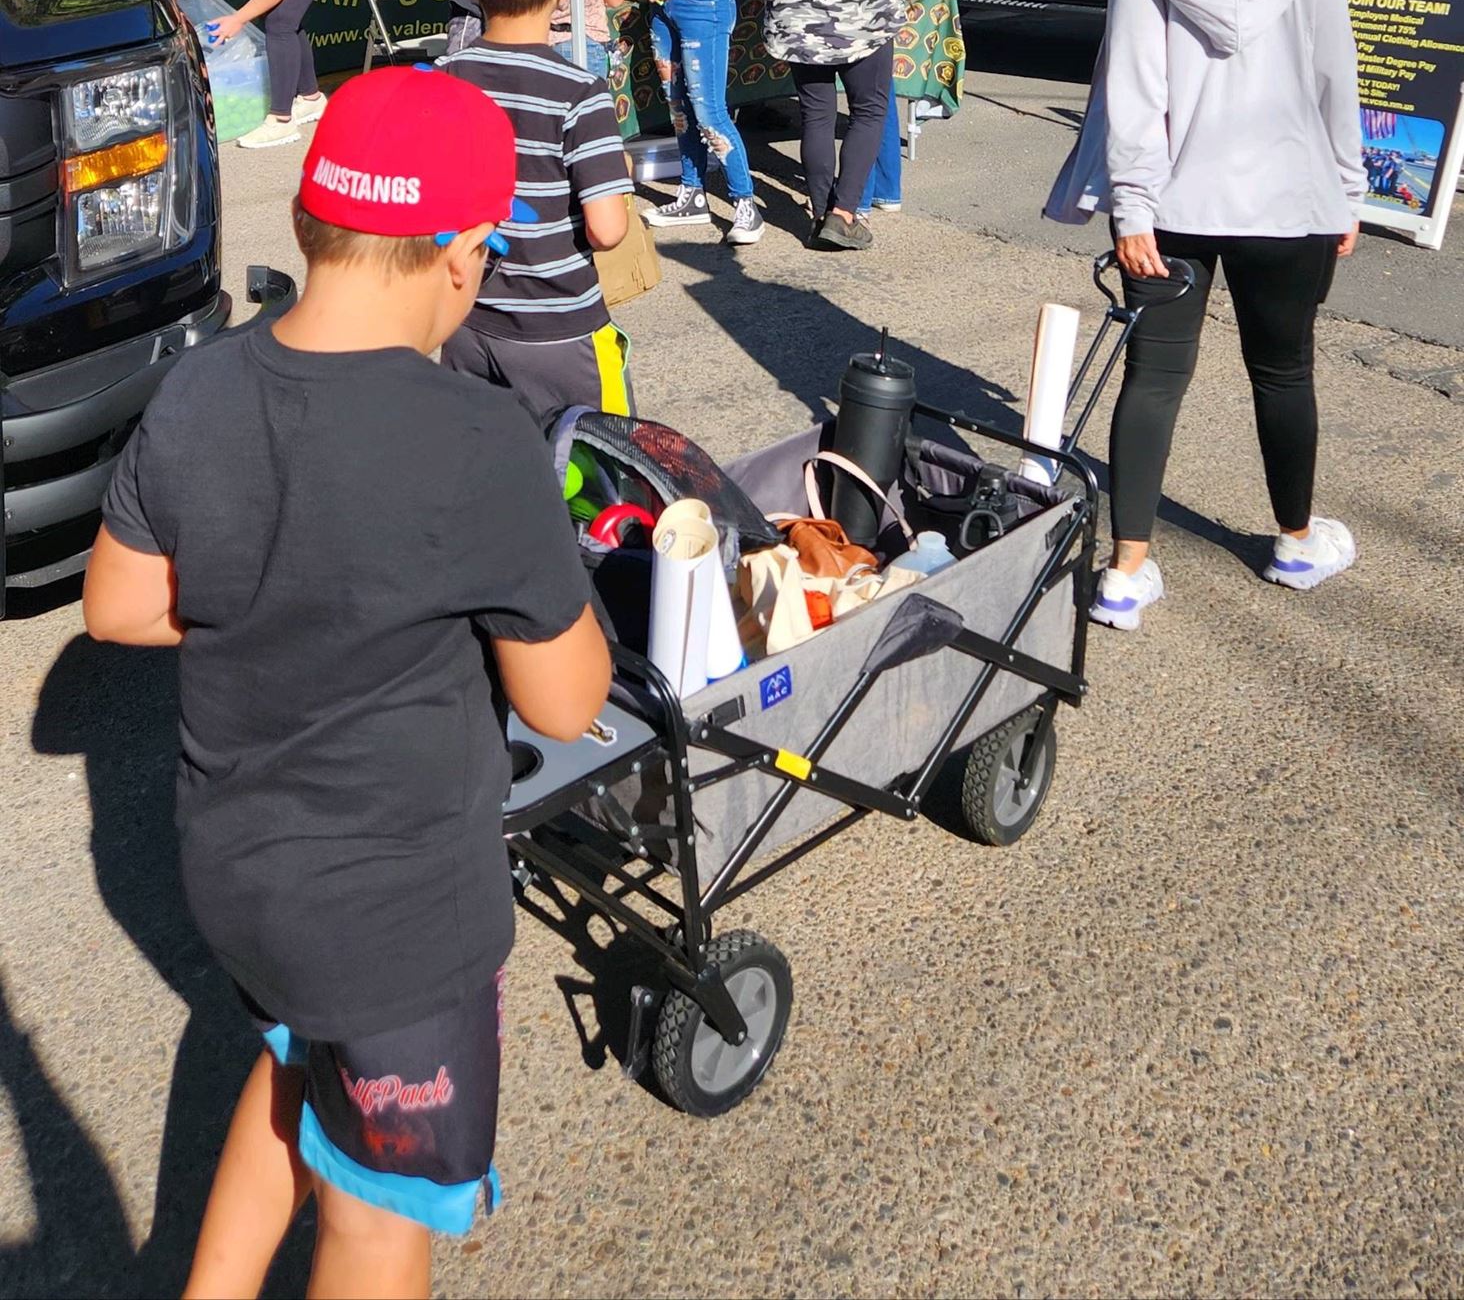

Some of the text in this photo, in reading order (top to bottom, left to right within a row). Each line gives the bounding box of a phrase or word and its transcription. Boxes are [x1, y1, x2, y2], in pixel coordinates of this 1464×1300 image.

[1408, 0, 1451, 15] TEAM!
[1349, 8, 1425, 25] Employee Medical
[1352, 20, 1417, 35] tirement at 75%
[1352, 30, 1381, 42] Annual
[1381, 34, 1419, 48] Clothing
[1357, 42, 1375, 53] Pay
[1386, 56, 1417, 69] Degree
[1418, 61, 1437, 72] Pay
[1365, 64, 1398, 79] Military
[1398, 68, 1417, 81] Pay
[1371, 80, 1400, 91] TODAY!
[312, 156, 421, 204] MUSTANGS
[767, 686, 788, 703] MAC
